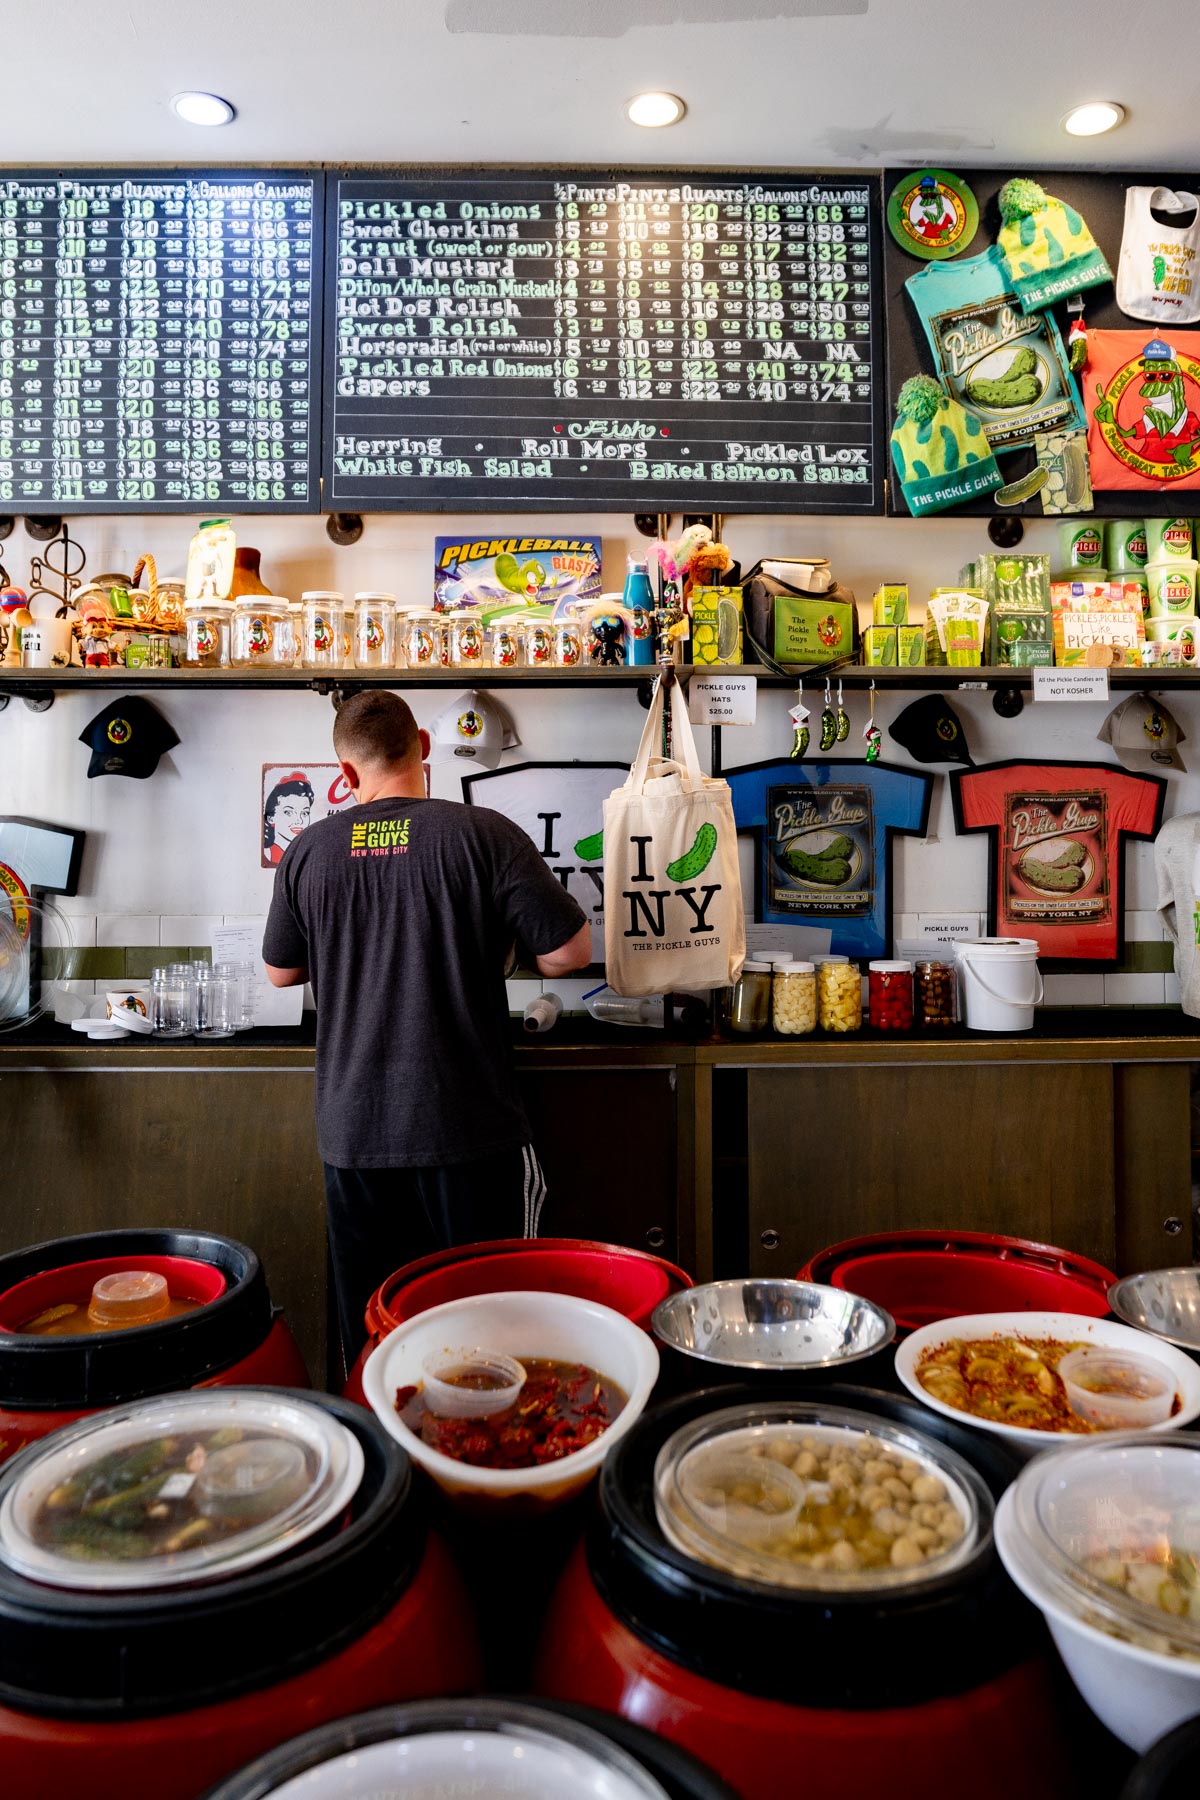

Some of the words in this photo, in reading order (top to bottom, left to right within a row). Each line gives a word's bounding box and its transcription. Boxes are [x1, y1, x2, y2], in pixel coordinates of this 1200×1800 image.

[254, 181, 312, 199] GALLONS
[682, 184, 744, 202] QUARTS
[808, 186, 869, 203] GALLONS
[340, 201, 447, 219] Pickled
[460, 202, 541, 219] Onions
[341, 220, 402, 238] Sweet
[408, 220, 519, 239] Gherkins
[340, 239, 418, 257] Kraut
[426, 239, 484, 258] (sweet
[485, 244, 503, 255] or
[507, 241, 553, 258] sour)
[340, 258, 399, 276] Deli
[409, 258, 515, 277] Mustard
[453, 279, 498, 297] Grain
[498, 279, 555, 297] Mustard
[1022, 289, 1043, 305] THE
[1046, 275, 1080, 297] PICKLE
[1080, 263, 1108, 282] GUYS
[338, 297, 381, 316] Hot
[385, 297, 431, 316] Dog
[436, 298, 521, 317] Relish
[339, 317, 417, 336] Sweet
[429, 318, 518, 337] Relish
[962, 321, 982, 337] The
[496, 343, 510, 353] or
[511, 338, 552, 356] white)
[762, 342, 802, 360] NA
[944, 327, 998, 377] Pickle
[1000, 307, 1040, 340] Guys
[826, 343, 861, 361] NA
[340, 357, 445, 376] Pickled
[449, 359, 489, 376] Red
[493, 359, 553, 377] Onions
[1109, 367, 1135, 399] PICKLE
[568, 420, 656, 439] Fish
[987, 432, 1011, 442] NEW
[1012, 425, 1043, 437] YORK,
[1043, 417, 1058, 427] NY
[335, 437, 442, 456] Herring
[522, 440, 570, 457] Roll
[726, 443, 815, 463] Pickled
[816, 445, 869, 464] Lox
[1105, 427, 1128, 460] SMELLS
[335, 457, 413, 476] White
[419, 458, 473, 476] Fish
[483, 458, 552, 477] Salad
[629, 461, 707, 480] Baked
[711, 462, 797, 482] Salmon
[803, 463, 869, 483] Salad
[911, 493, 933, 507] THE
[935, 481, 972, 500] PICKLE
[975, 471, 1000, 490] GUYS
[1164, 530, 1191, 541] PICKLE
[440, 538, 593, 568] PICKLEBALL
[1075, 542, 1101, 552] PICKLE
[552, 556, 596, 575] BLAST!
[694, 611, 715, 620] PICKLE
[788, 625, 809, 633] Pickle
[789, 635, 807, 643] Guys
[786, 646, 803, 654] Lower
[795, 800, 812, 811] The
[1032, 807, 1047, 818] The
[368, 819, 411, 832] PICKLE
[775, 804, 822, 842] Pickle
[828, 796, 866, 822] Guys
[1012, 811, 1057, 851] Pickle
[1063, 802, 1099, 830] Guys
[351, 823, 367, 849] THE
[367, 830, 409, 848] GUYS
[351, 849, 367, 857] NEW
[370, 848, 389, 856] YORK
[392, 846, 408, 854] CITY
[630, 835, 654, 882] I
[622, 884, 722, 937] NY
[632, 943, 652, 951] THE
[655, 940, 691, 950] PICKLE
[694, 936, 721, 947] GUYS
